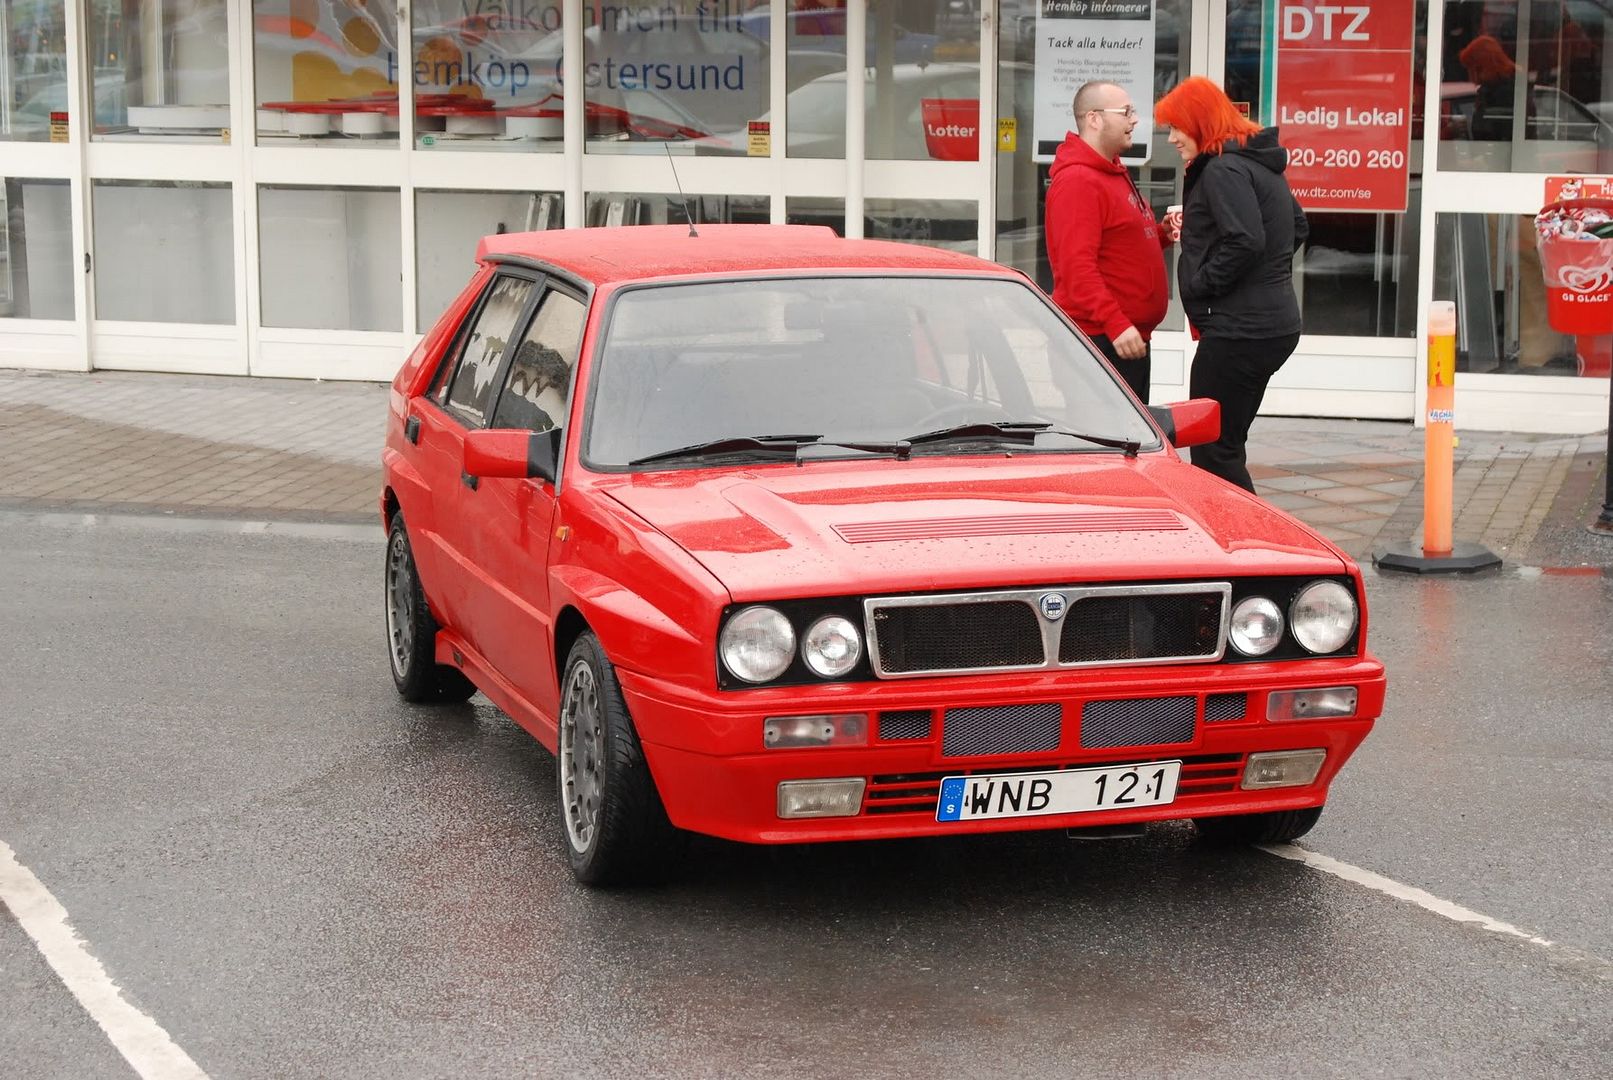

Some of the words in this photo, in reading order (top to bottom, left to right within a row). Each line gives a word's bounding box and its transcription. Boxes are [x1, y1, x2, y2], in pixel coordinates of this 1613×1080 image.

[1046, 0, 1088, 15] Hemköp
[1091, 0, 1148, 13] informerar
[696, 0, 744, 33] till
[1283, 6, 1370, 41] DTZ
[1048, 37, 1074, 48] Tack
[1077, 37, 1096, 49] alla
[1100, 37, 1143, 49] kunder!
[555, 48, 744, 91] stersund
[1281, 106, 1339, 129] Ledig
[1346, 107, 1403, 126] Lokal
[928, 124, 976, 137] Lotter
[1367, 149, 1404, 169] 260
[1289, 185, 1371, 199] ww.dtz.com/se
[1562, 293, 1575, 302] GB
[1577, 294, 1609, 303] GLACE
[970, 779, 1053, 815] WNB
[1094, 768, 1165, 806] 121
[945, 804, 955, 814] S
